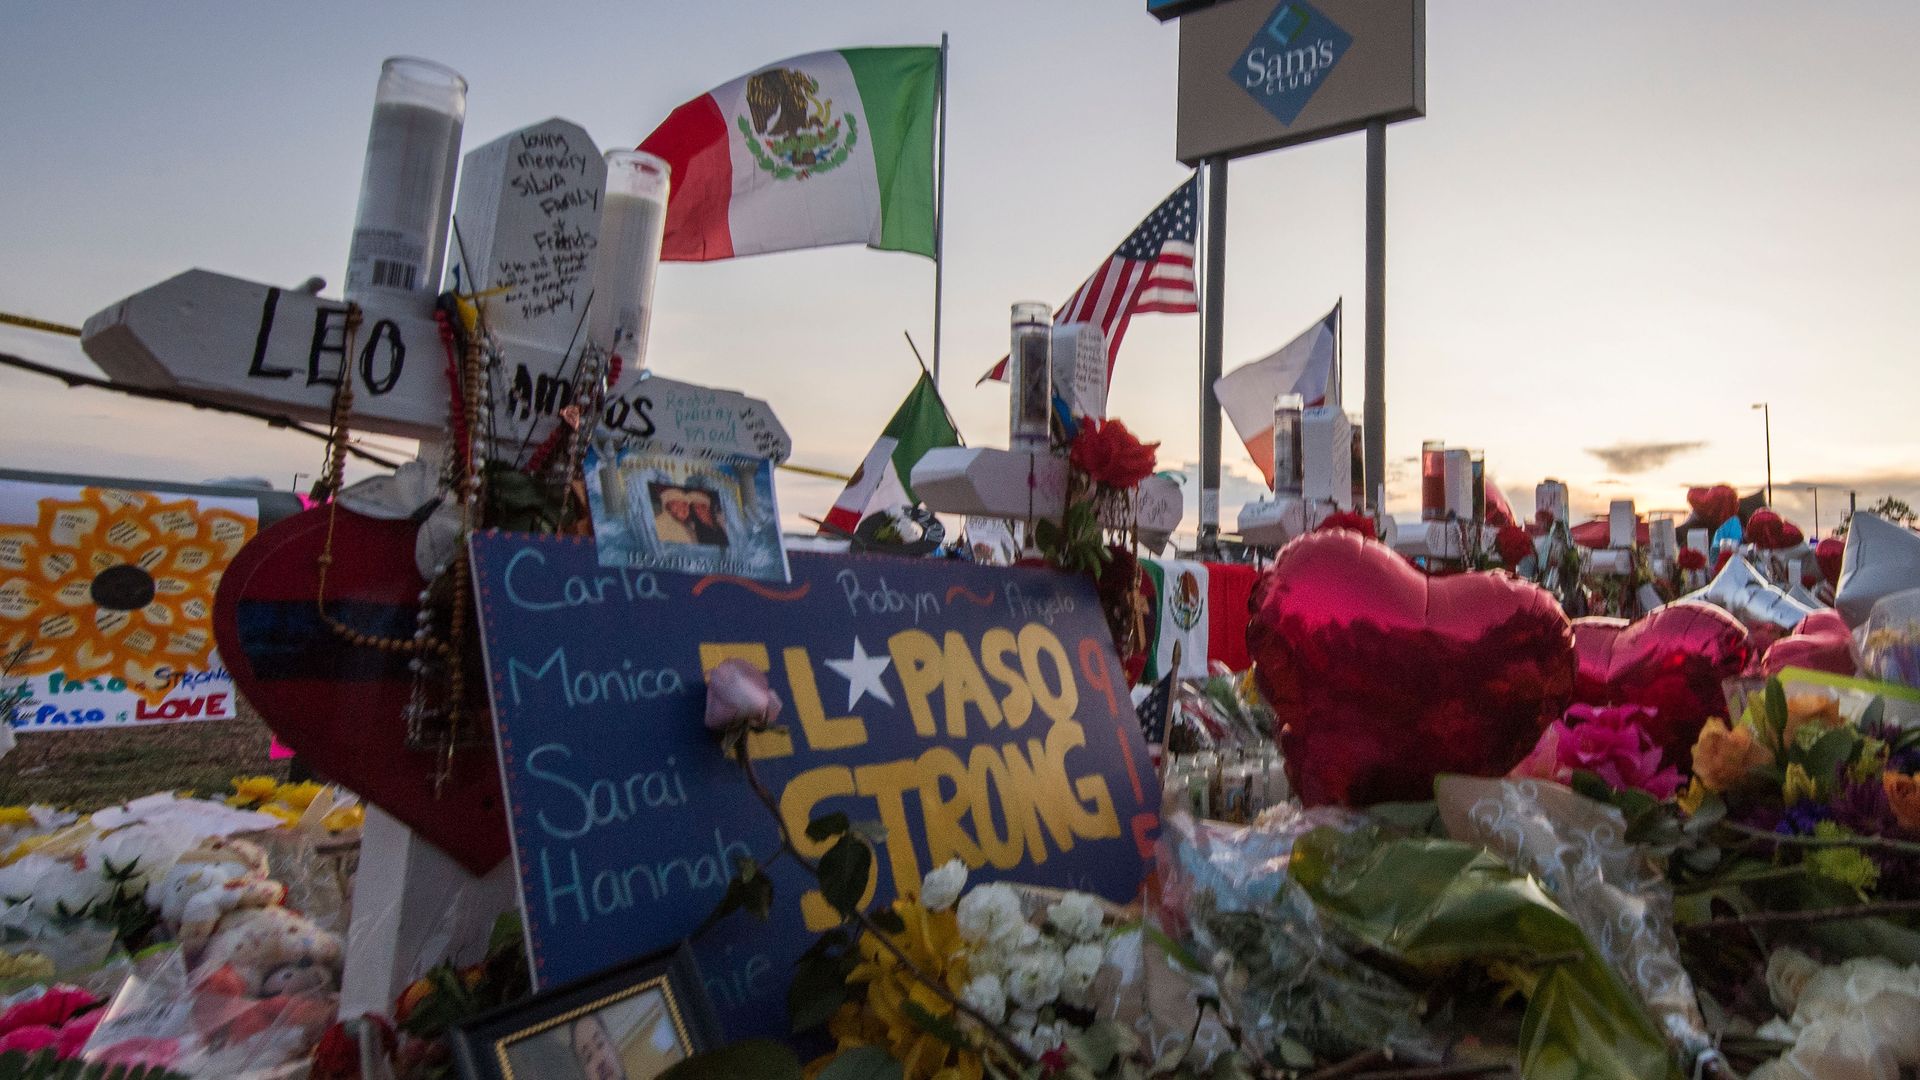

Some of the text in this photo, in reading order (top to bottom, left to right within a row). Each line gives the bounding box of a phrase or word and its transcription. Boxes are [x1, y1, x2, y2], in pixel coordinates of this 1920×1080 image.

[1246, 38, 1333, 89] Sam's
[1265, 74, 1314, 95] CLUB
[248, 286, 406, 396] LEO
[504, 547, 671, 611] Carla
[836, 568, 941, 625] Robyn
[135, 693, 229, 720] LOVE
[508, 647, 686, 709] Monica
[888, 623, 1080, 738] PASO
[526, 743, 688, 839] Sarai
[779, 720, 1122, 932] STRONG
[540, 828, 751, 926] Hannah
